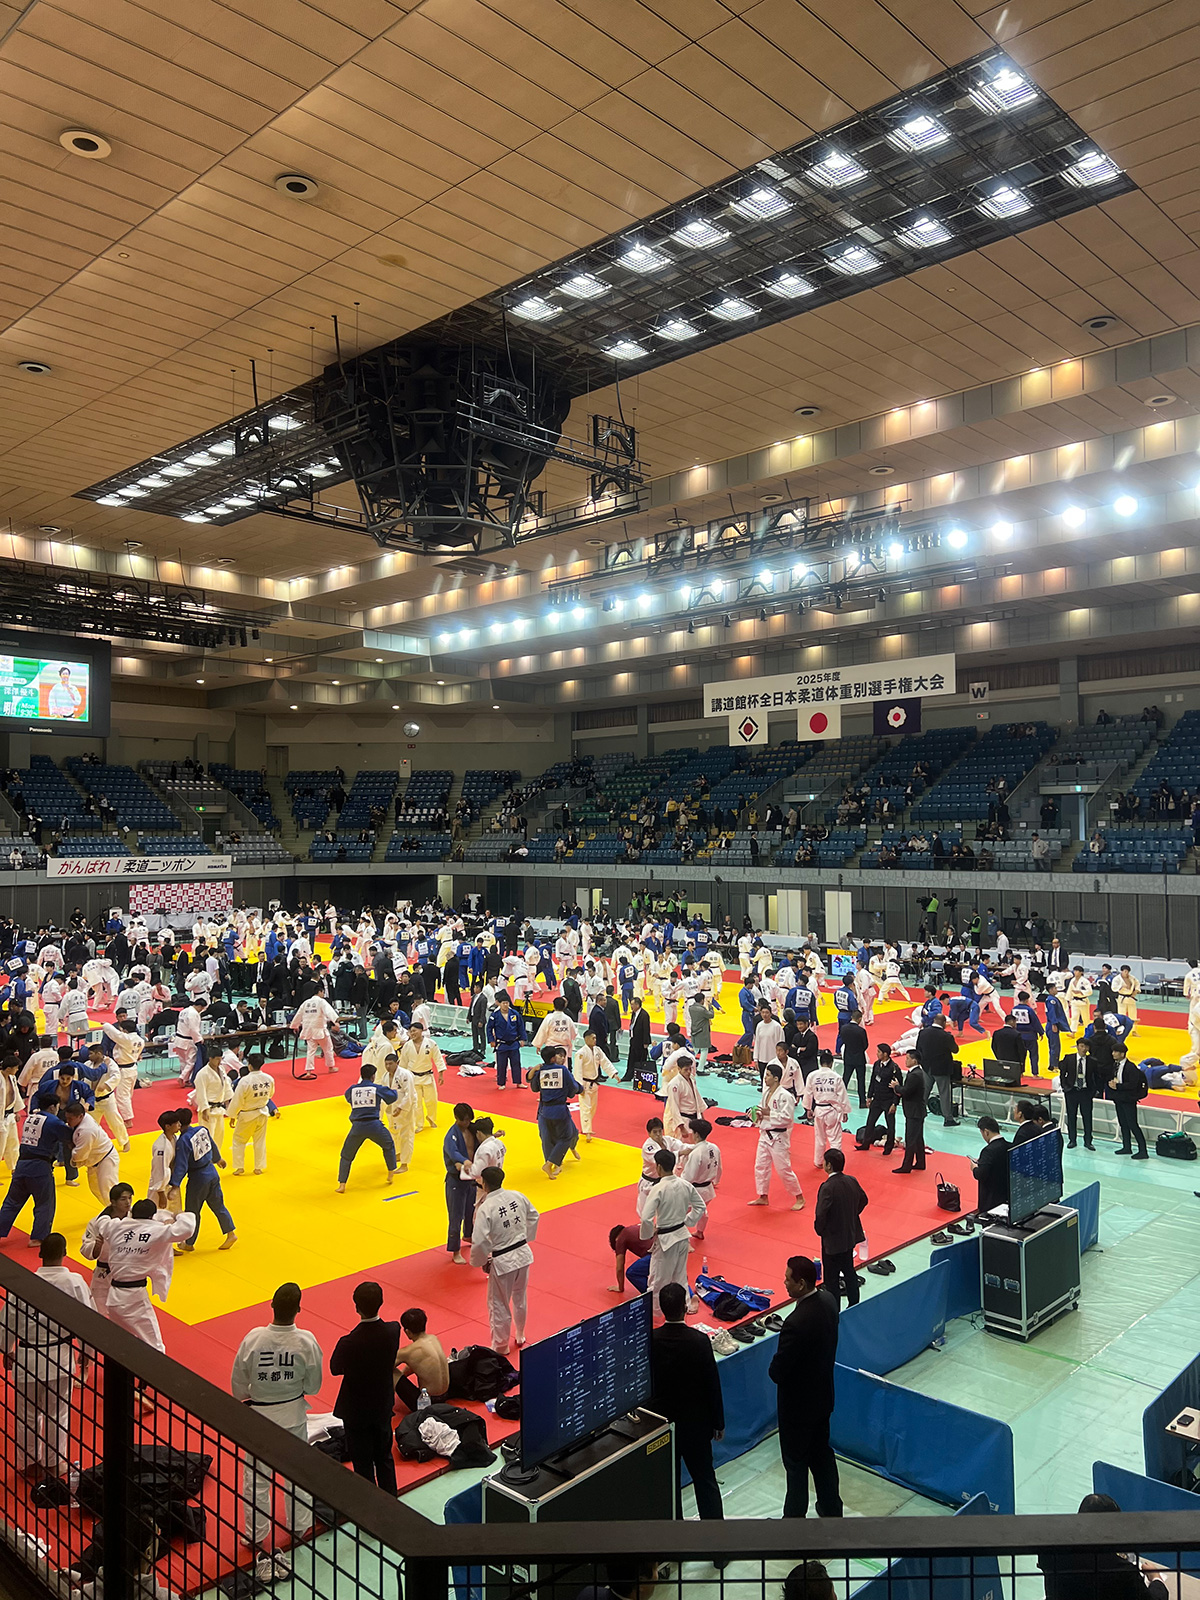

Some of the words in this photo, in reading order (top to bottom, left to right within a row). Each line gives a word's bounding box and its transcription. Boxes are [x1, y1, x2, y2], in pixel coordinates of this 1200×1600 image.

[797, 671, 841, 685] 2025年度
[711, 673, 945, 713] 講道館杯全日本柔道体重別選手権大会
[971, 685, 987, 699] W
[640, 1072, 654, 1083] 4:00
[815, 1077, 835, 1085] 三ツ石
[252, 1081, 270, 1091] 佐々木
[355, 1089, 372, 1097] 竹下
[498, 1200, 519, 1218] 井手
[503, 1215, 521, 1228] 明大
[258, 1351, 294, 1367] 三山
[257, 1370, 294, 1381] 京都刑
